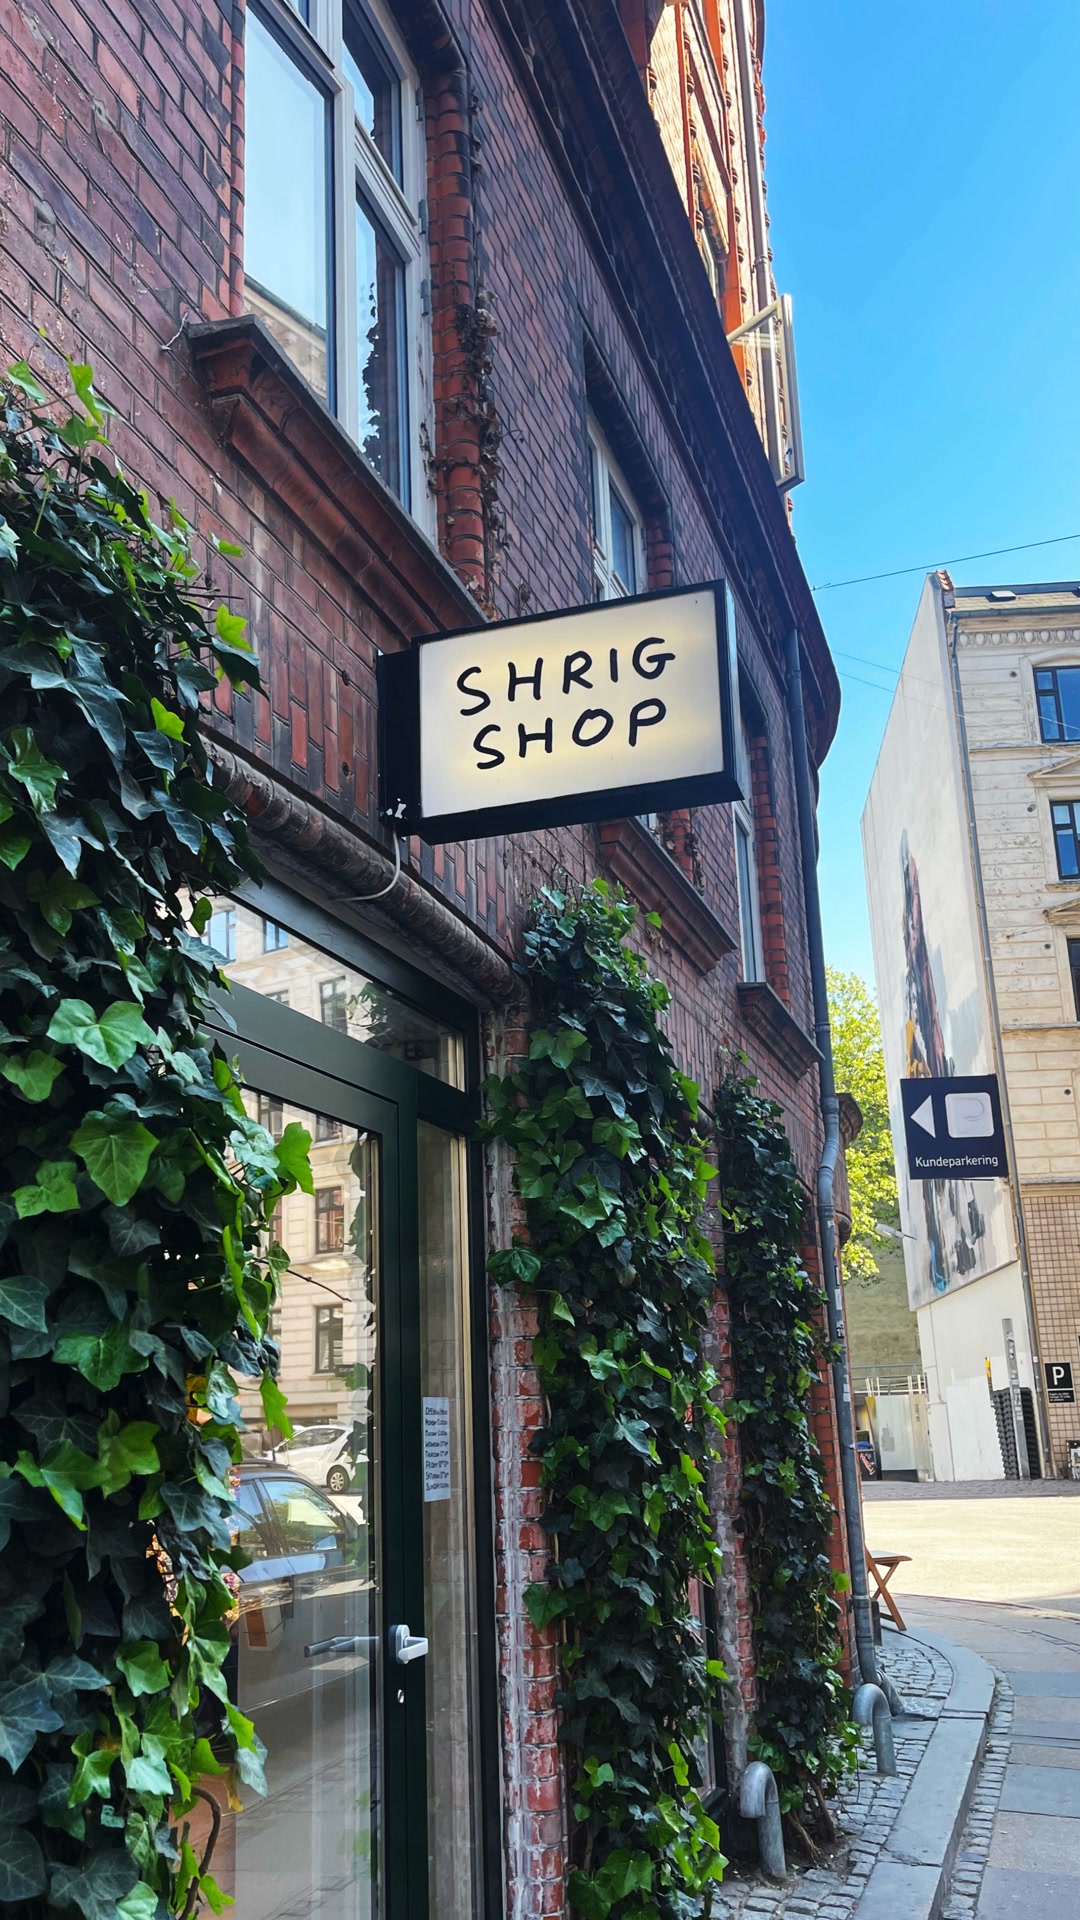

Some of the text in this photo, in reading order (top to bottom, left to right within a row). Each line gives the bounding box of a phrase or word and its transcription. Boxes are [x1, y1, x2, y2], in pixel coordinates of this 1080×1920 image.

[456, 637, 676, 716] SHRIG
[473, 698, 667, 770] SHOP
[915, 1155, 999, 1168] Kundeparkering
[1052, 1366, 1065, 1386] P
